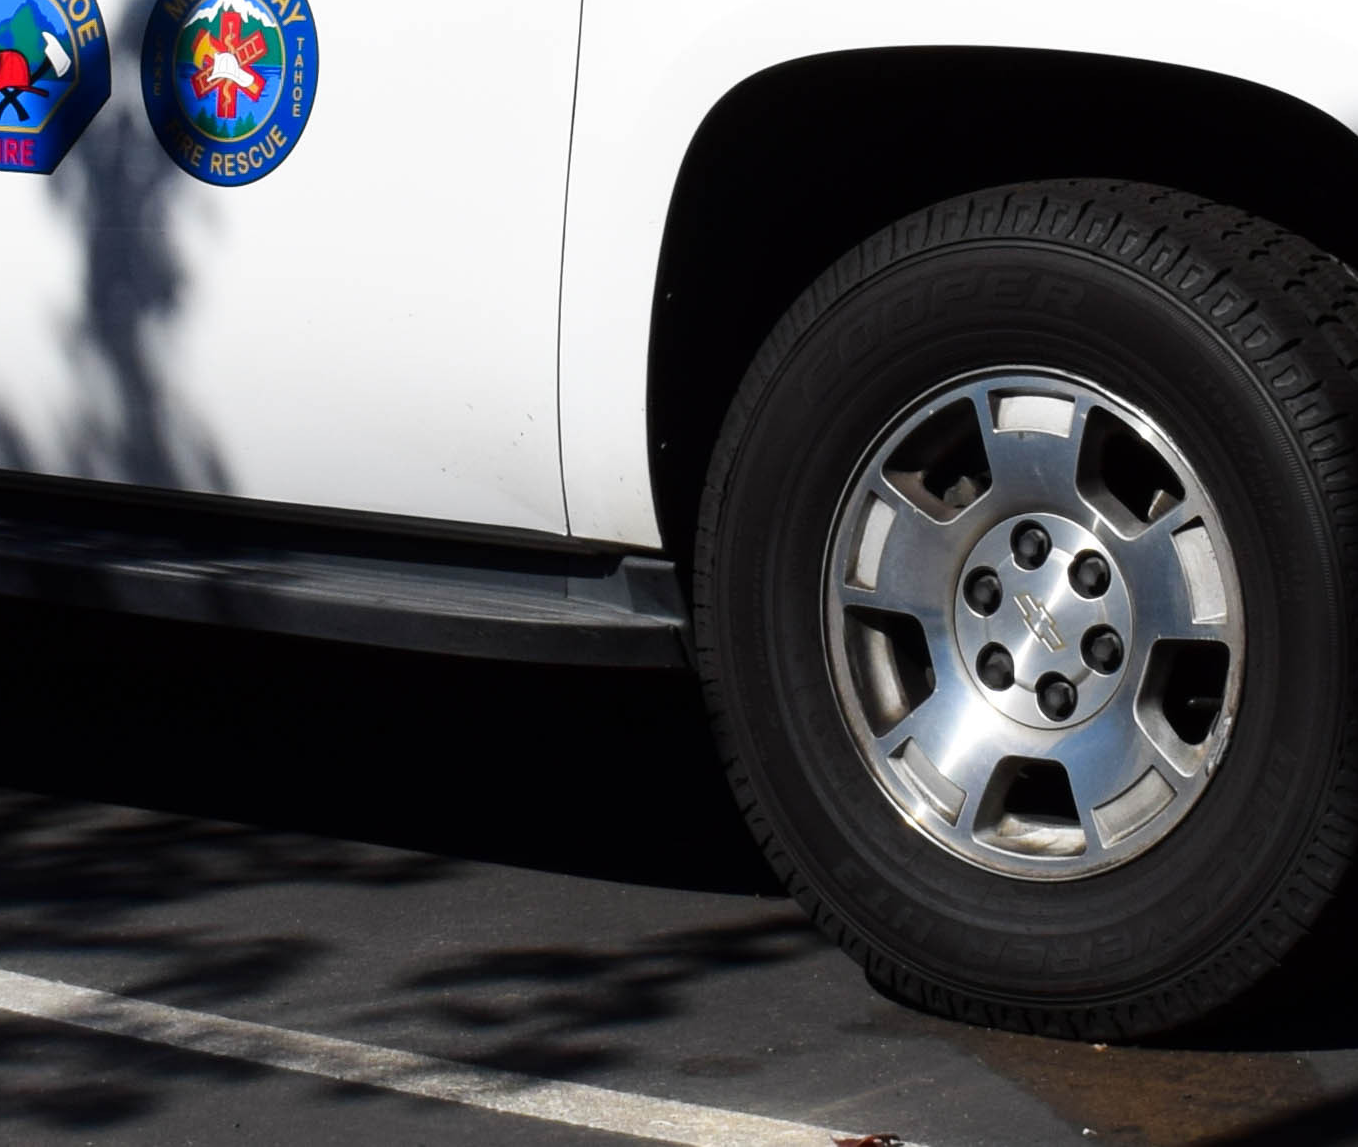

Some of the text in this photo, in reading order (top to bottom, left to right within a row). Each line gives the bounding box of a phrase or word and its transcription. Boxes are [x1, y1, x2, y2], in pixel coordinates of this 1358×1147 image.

[291, 36, 306, 118] TAHOE
[165, 118, 288, 178] FIRE RESCUE
